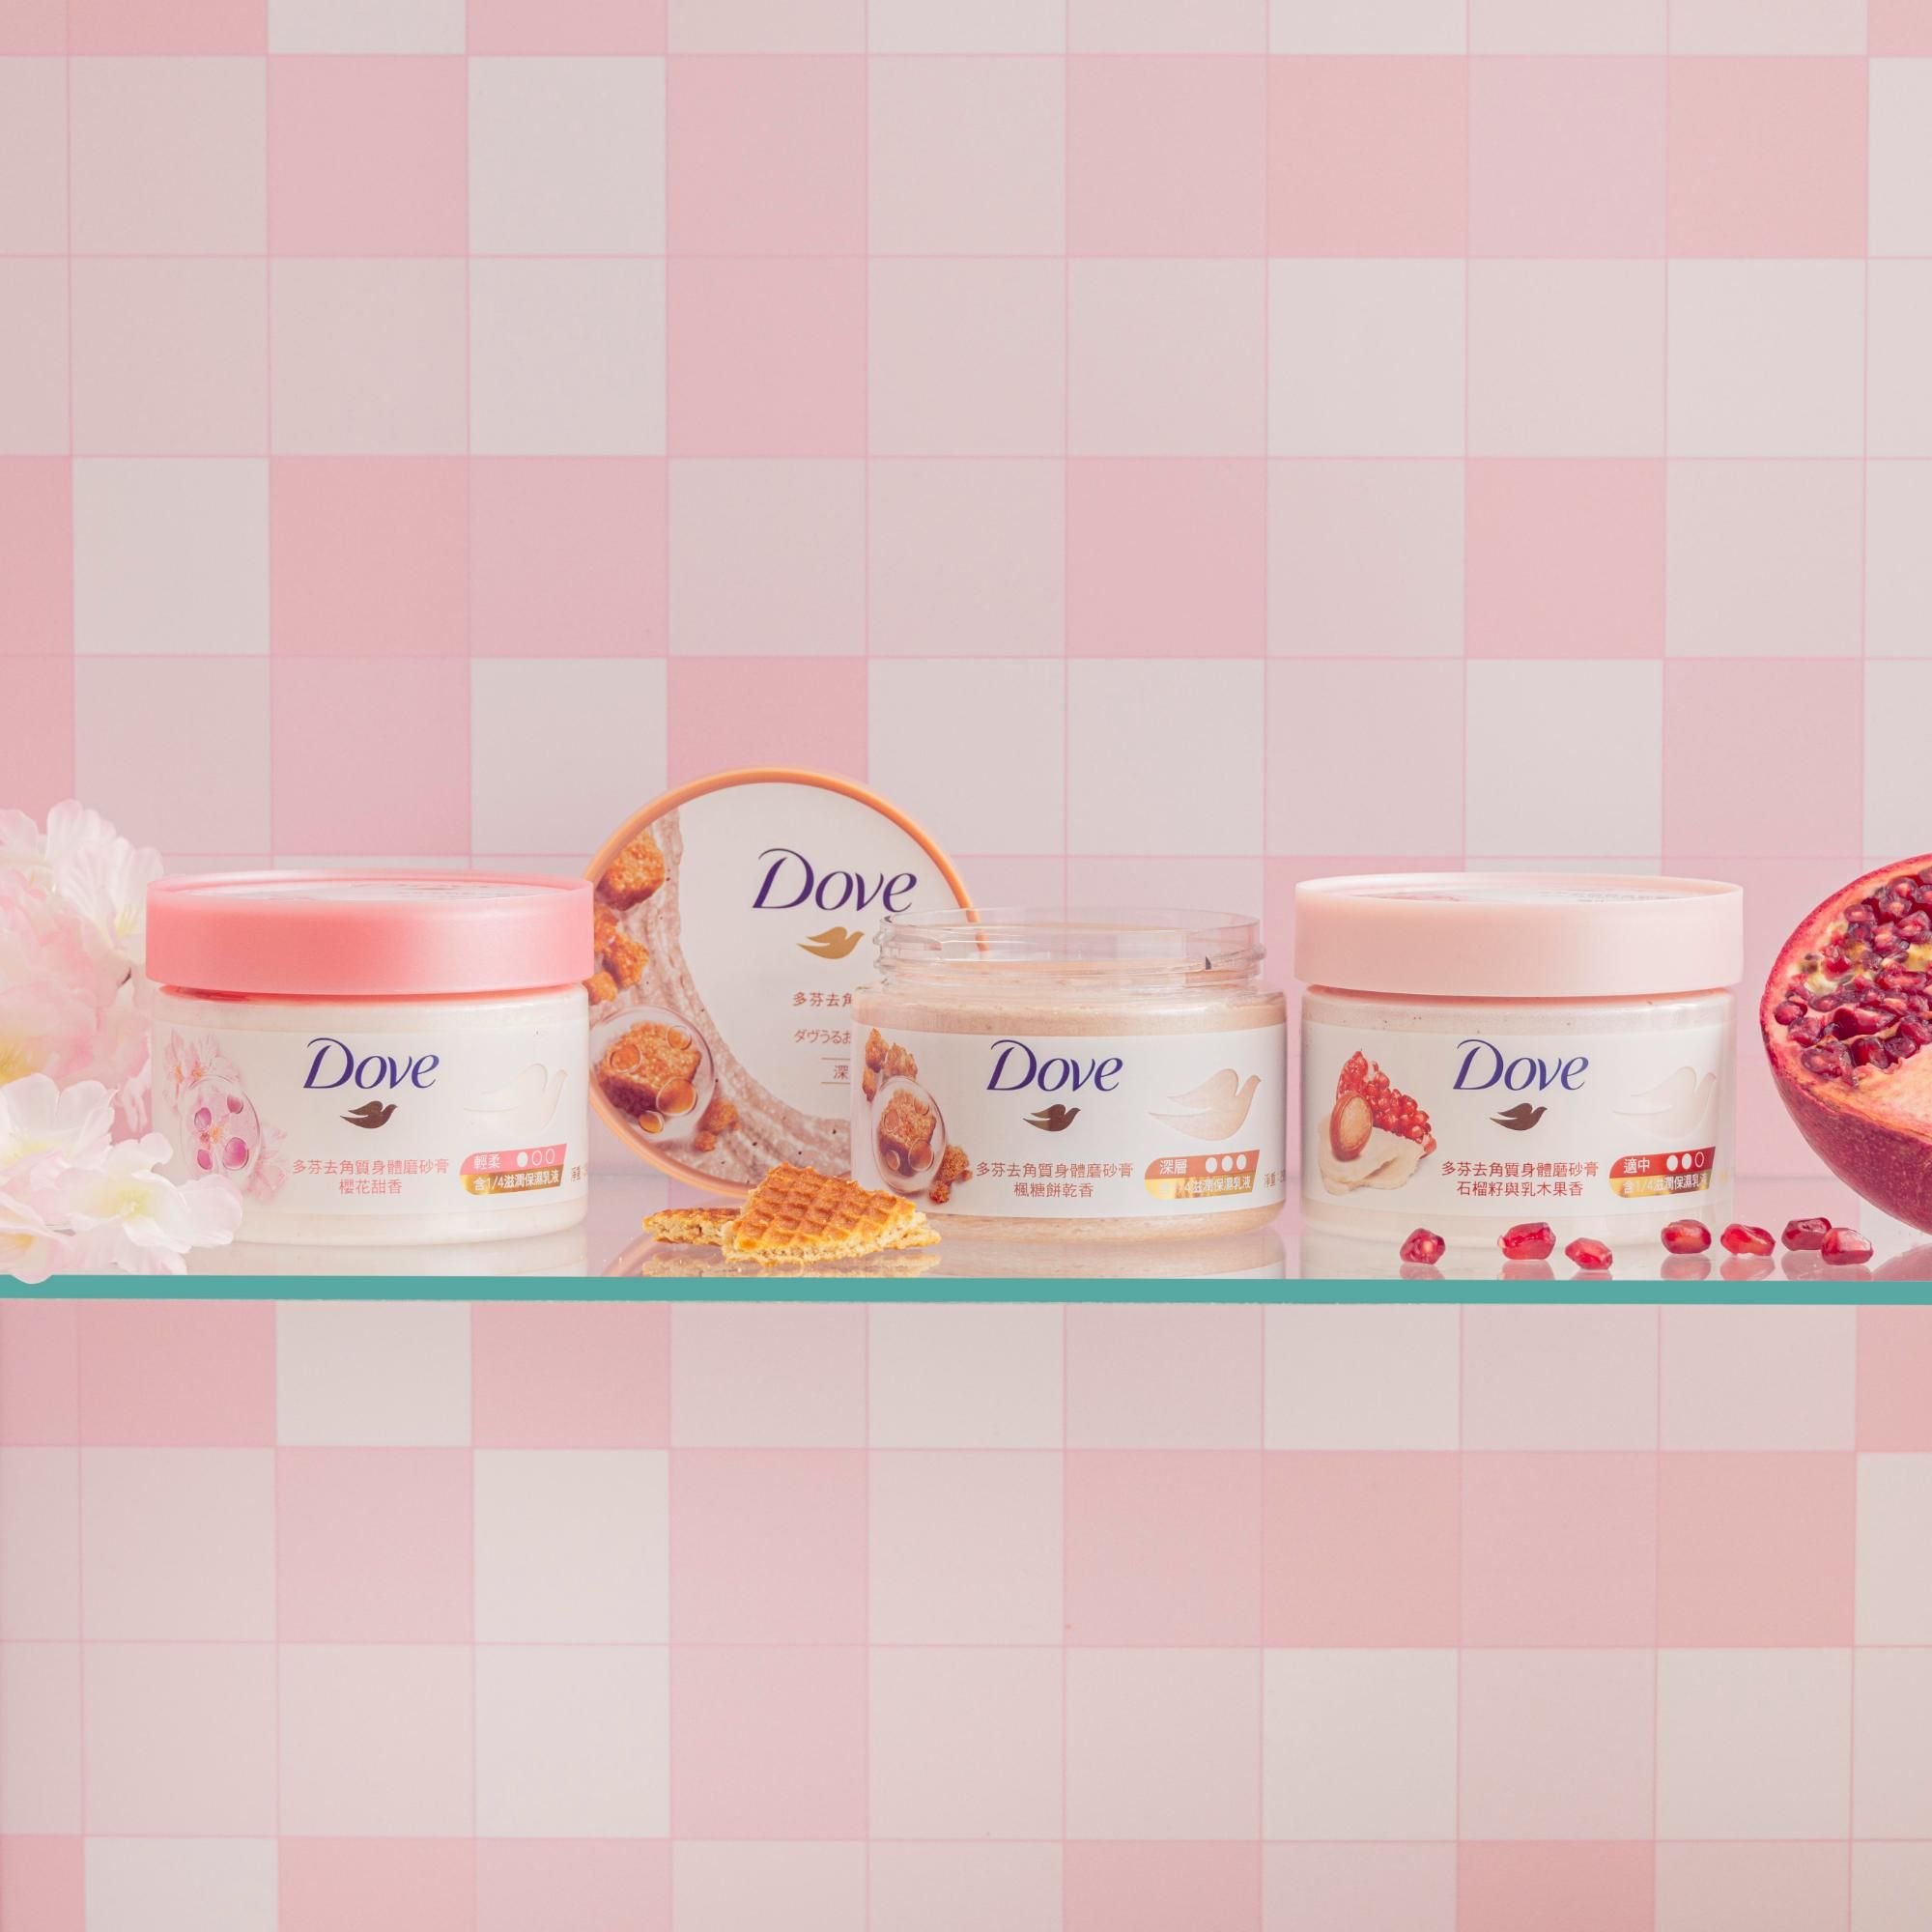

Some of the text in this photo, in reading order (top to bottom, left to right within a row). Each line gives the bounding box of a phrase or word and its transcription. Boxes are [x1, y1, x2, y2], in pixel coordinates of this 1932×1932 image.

[752, 847, 917, 913] Dove
[302, 1037, 440, 1090] Dove
[986, 1039, 1123, 1092] Dove
[1453, 1038, 1589, 1091] Dove
[293, 1158, 449, 1176] 多芬去角質身體磨砂膏
[473, 1153, 501, 1171] 輕柔
[976, 1161, 1133, 1179] 多芬去角質身體磨砂膏
[1159, 1158, 1188, 1176] 深層
[1441, 1160, 1600, 1178] 多芬去角質身體磨砂膏
[1623, 1156, 1651, 1174] 適中
[339, 1179, 403, 1195] 櫻花甜香
[1013, 1181, 1094, 1199] 楓糖餅乾香
[1457, 1180, 1584, 1197] 石榴籽與乳木果香
